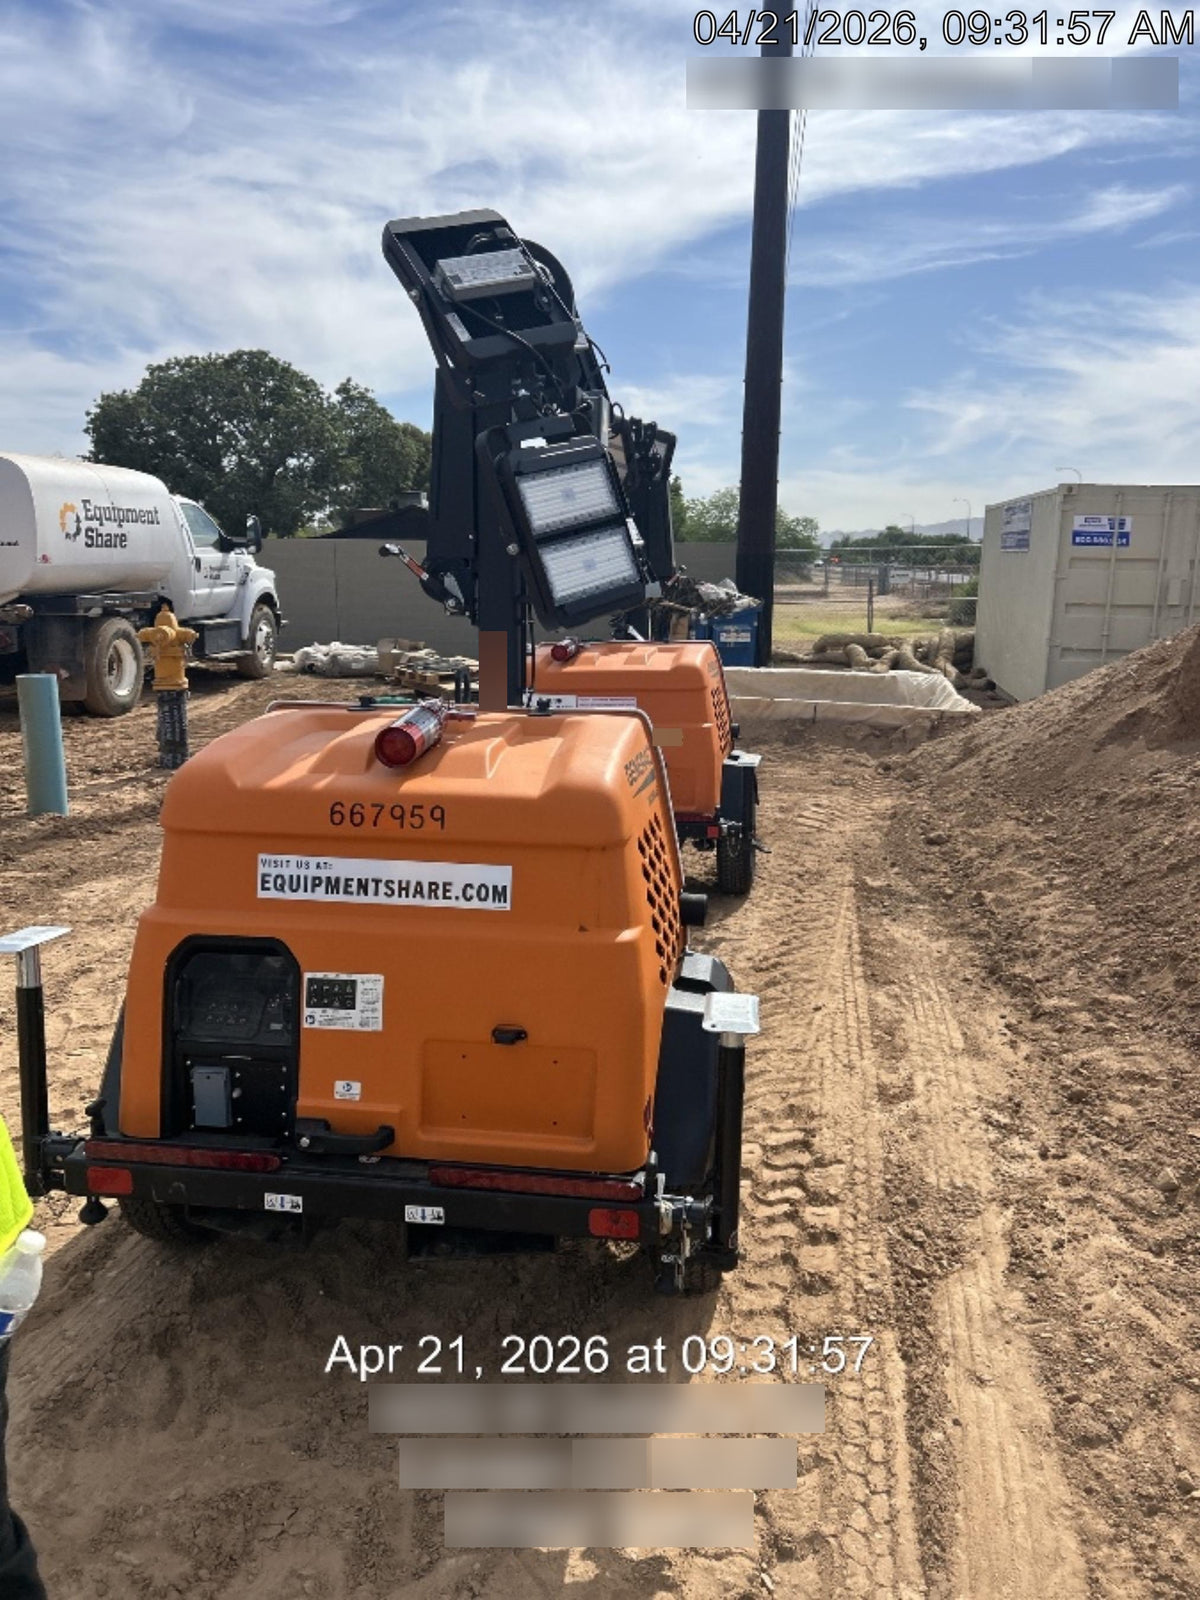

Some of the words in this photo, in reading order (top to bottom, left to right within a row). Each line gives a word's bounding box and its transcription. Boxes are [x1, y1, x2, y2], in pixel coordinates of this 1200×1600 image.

[81, 499, 160, 528] Equipment
[84, 526, 128, 549] Share
[329, 801, 446, 831] 667959
[260, 858, 291, 869] VISIT
[296, 859, 310, 870] US
[315, 861, 334, 870] AT:
[260, 872, 509, 904] EQUIPMENTSHARE.COM
